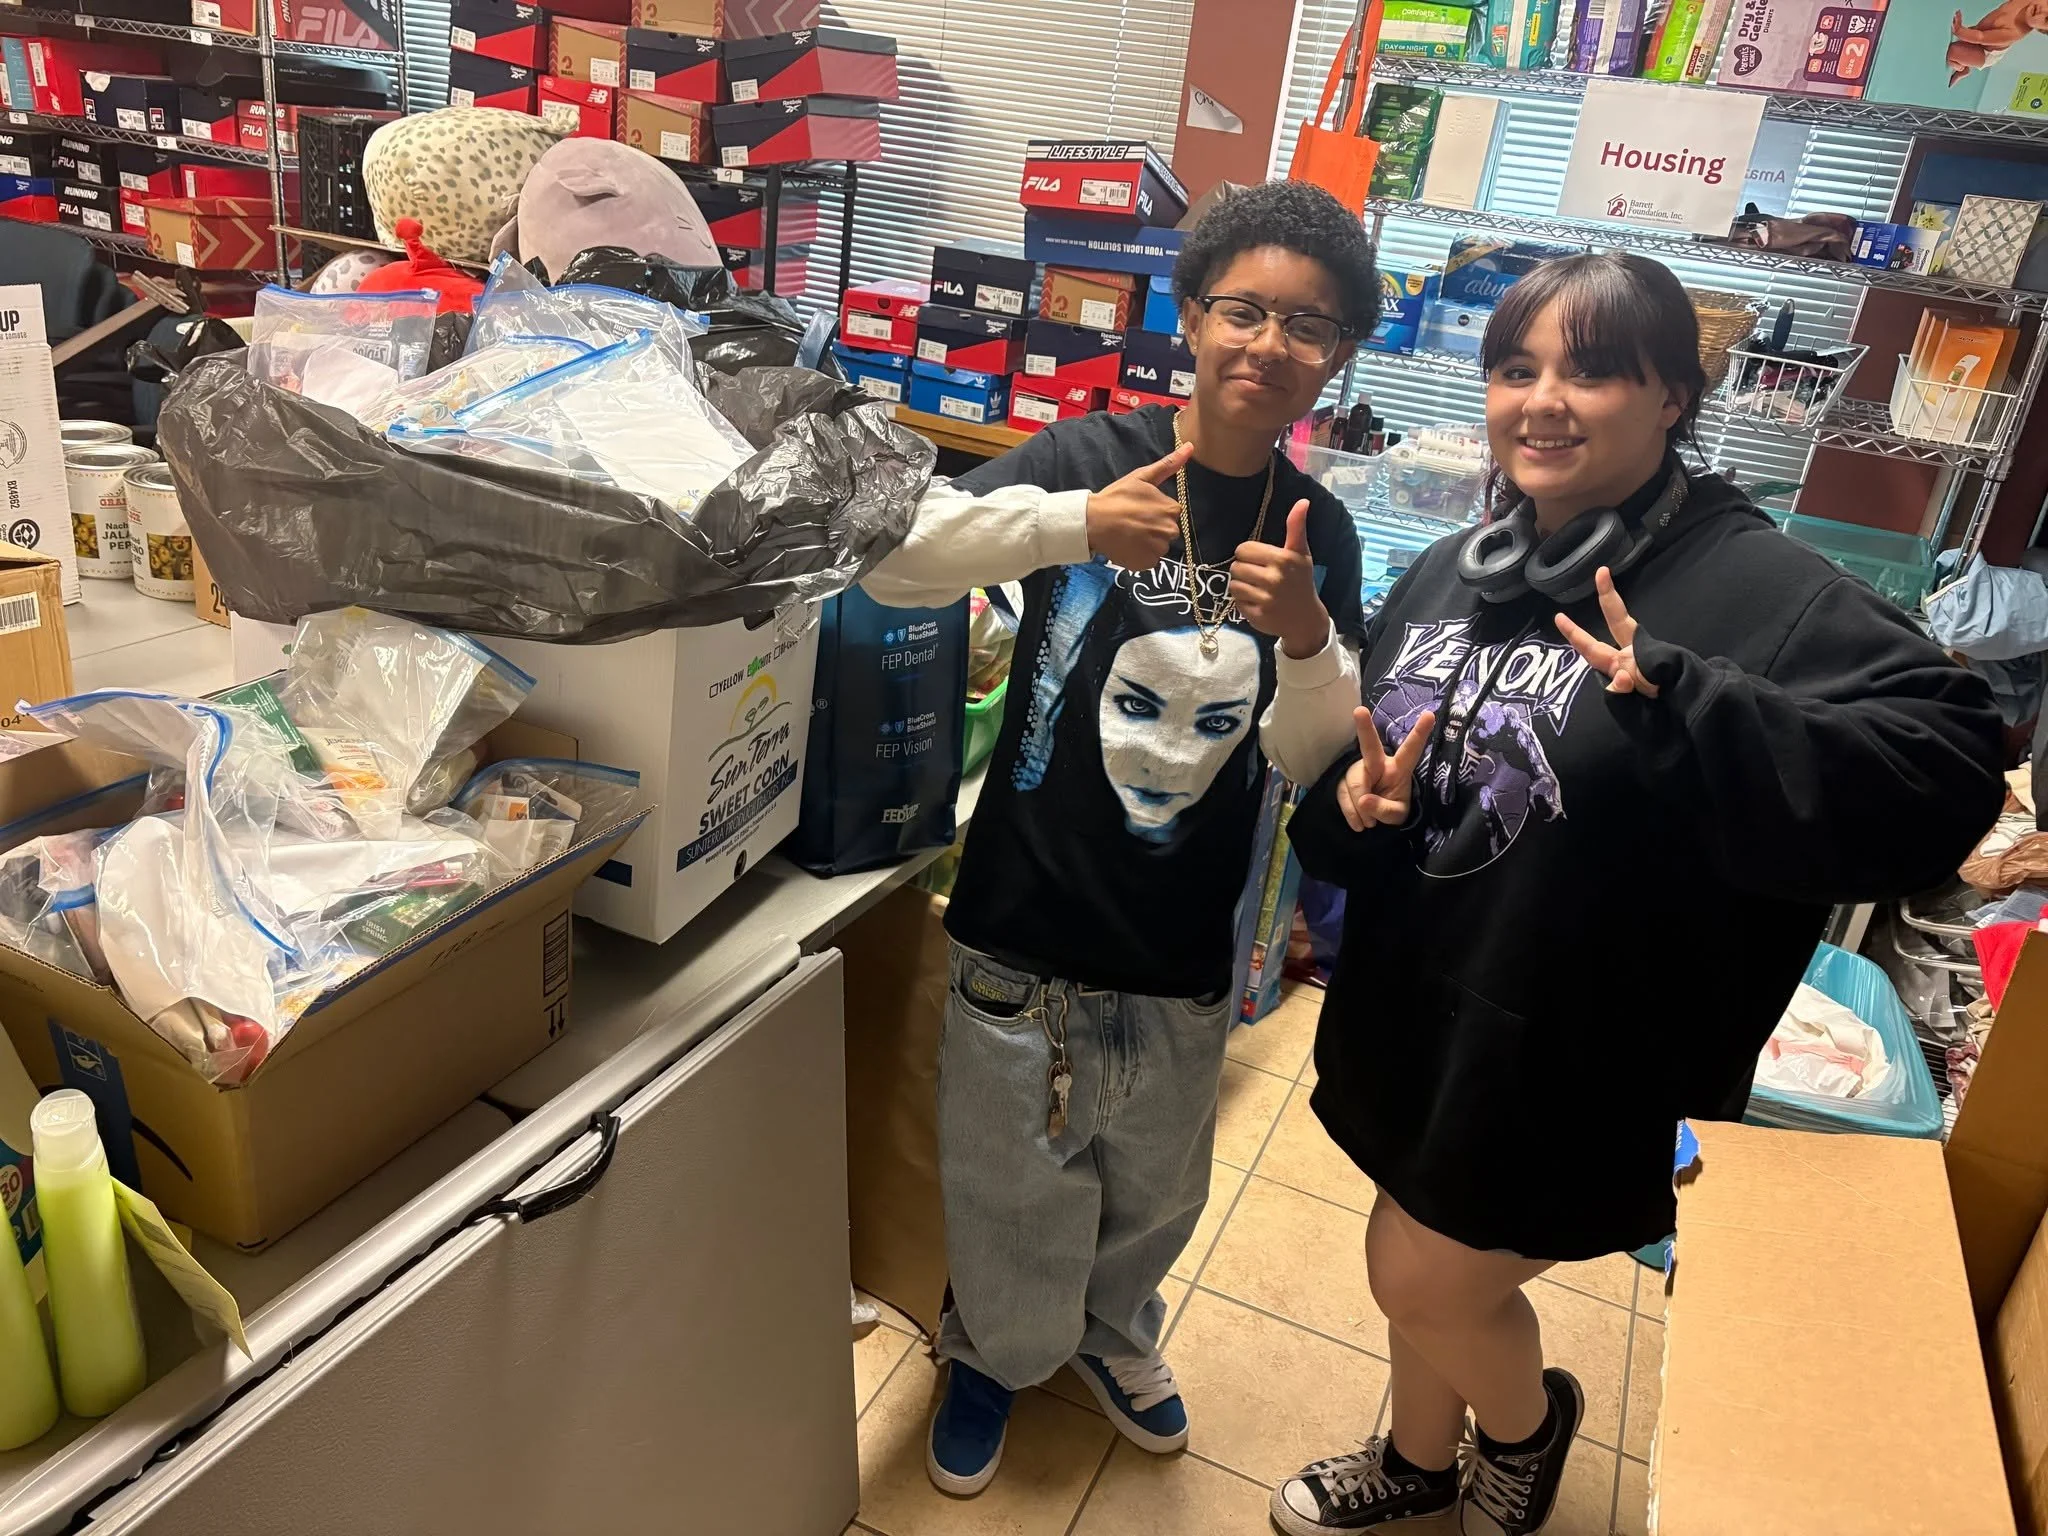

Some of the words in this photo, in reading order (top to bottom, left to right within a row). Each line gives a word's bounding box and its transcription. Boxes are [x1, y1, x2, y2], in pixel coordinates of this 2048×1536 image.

[297, 6, 379, 49] FILA
[1738, 13, 1755, 38] Dry
[1764, 8, 1775, 34] Diapers
[1849, 17, 1858, 31] 144
[792, 30, 812, 39] Reebok
[695, 38, 716, 47] Reebok
[1846, 43, 1865, 57] 2
[782, 98, 803, 108] Reebok
[241, 124, 263, 138] FILA
[61, 138, 90, 153] RUNNING
[161, 138, 168, 147] 8
[1048, 145, 1129, 160] LIFESTYLE
[58, 156, 75, 168] FILA
[1600, 142, 1727, 185] Housing
[724, 169, 733, 182] 9
[1024, 176, 1062, 192] FILA
[64, 186, 98, 200] RUNNING
[58, 202, 80, 216] FILA
[1137, 189, 1154, 217] FILA
[1629, 199, 1653, 209] Barrett
[1627, 206, 1669, 219] Foundation,
[1670, 210, 1684, 220] Inc.
[1087, 239, 1122, 253] SOLUTION
[1122, 242, 1144, 255] LOCAL
[1144, 245, 1164, 257] YOUR
[933, 280, 965, 296] FILA
[985, 319, 1008, 329] Reebok
[1100, 332, 1123, 341] Reebok
[1126, 364, 1158, 381] FILA
[7, 480, 21, 510] BX4862
[908, 620, 937, 633] BlueCross
[908, 627, 939, 641] BlueShield
[882, 652, 902, 671] FEP
[904, 644, 936, 667] Dental
[1380, 619, 1592, 726] VENOM
[718, 668, 745, 693] YELLOW
[906, 717, 937, 733] BlueShield
[907, 711, 936, 725] BlueCross
[875, 743, 900, 759] FEP
[903, 737, 933, 757] Vision
[699, 783, 751, 836] SWEET
[753, 749, 790, 795] CORN
[365, 919, 386, 935] IRISH
[361, 925, 388, 944] SPRING
